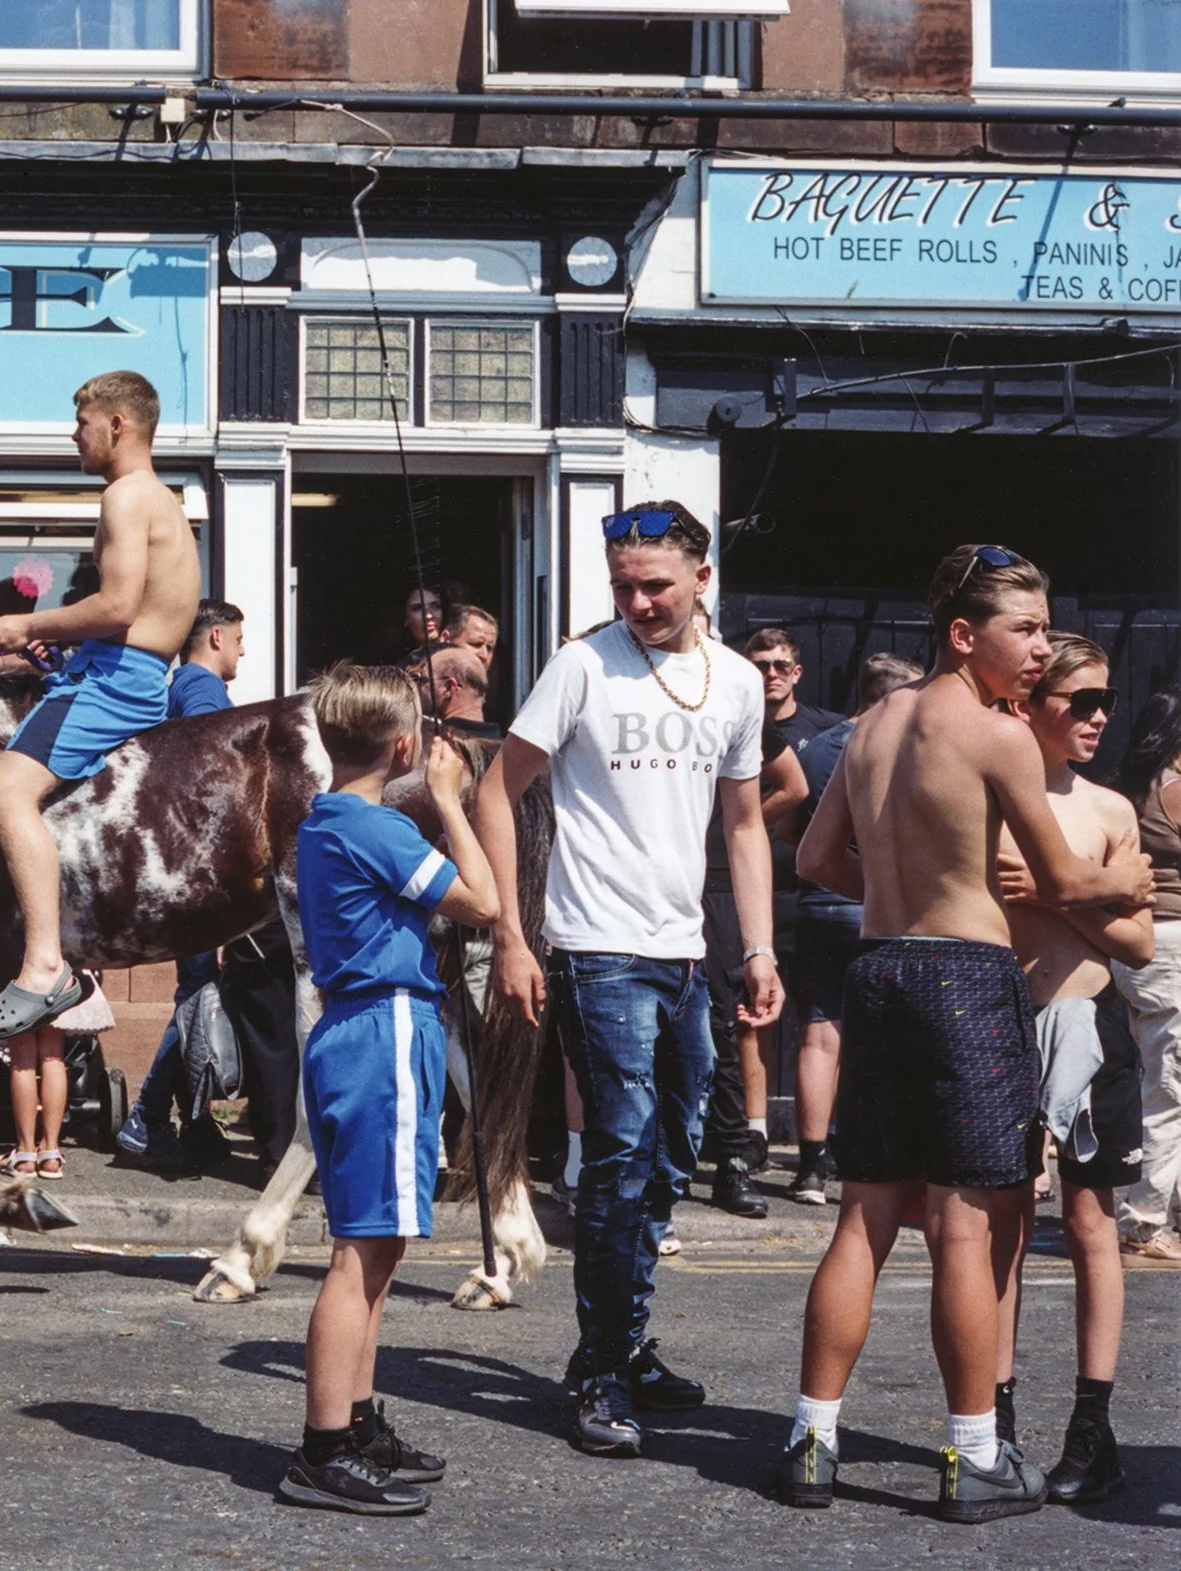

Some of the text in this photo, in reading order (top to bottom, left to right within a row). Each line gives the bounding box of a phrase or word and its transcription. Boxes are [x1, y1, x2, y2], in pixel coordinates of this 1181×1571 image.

[748, 173, 1037, 234] BAGUETTE
[1084, 183, 1130, 231] &
[774, 237, 825, 260] HOT
[841, 238, 902, 261] BEEF
[919, 240, 997, 264] ROLLS
[1033, 241, 1129, 267] PANINIS
[1021, 275, 1181, 302] TEAS & COF
[610, 759, 677, 770] HUGO
